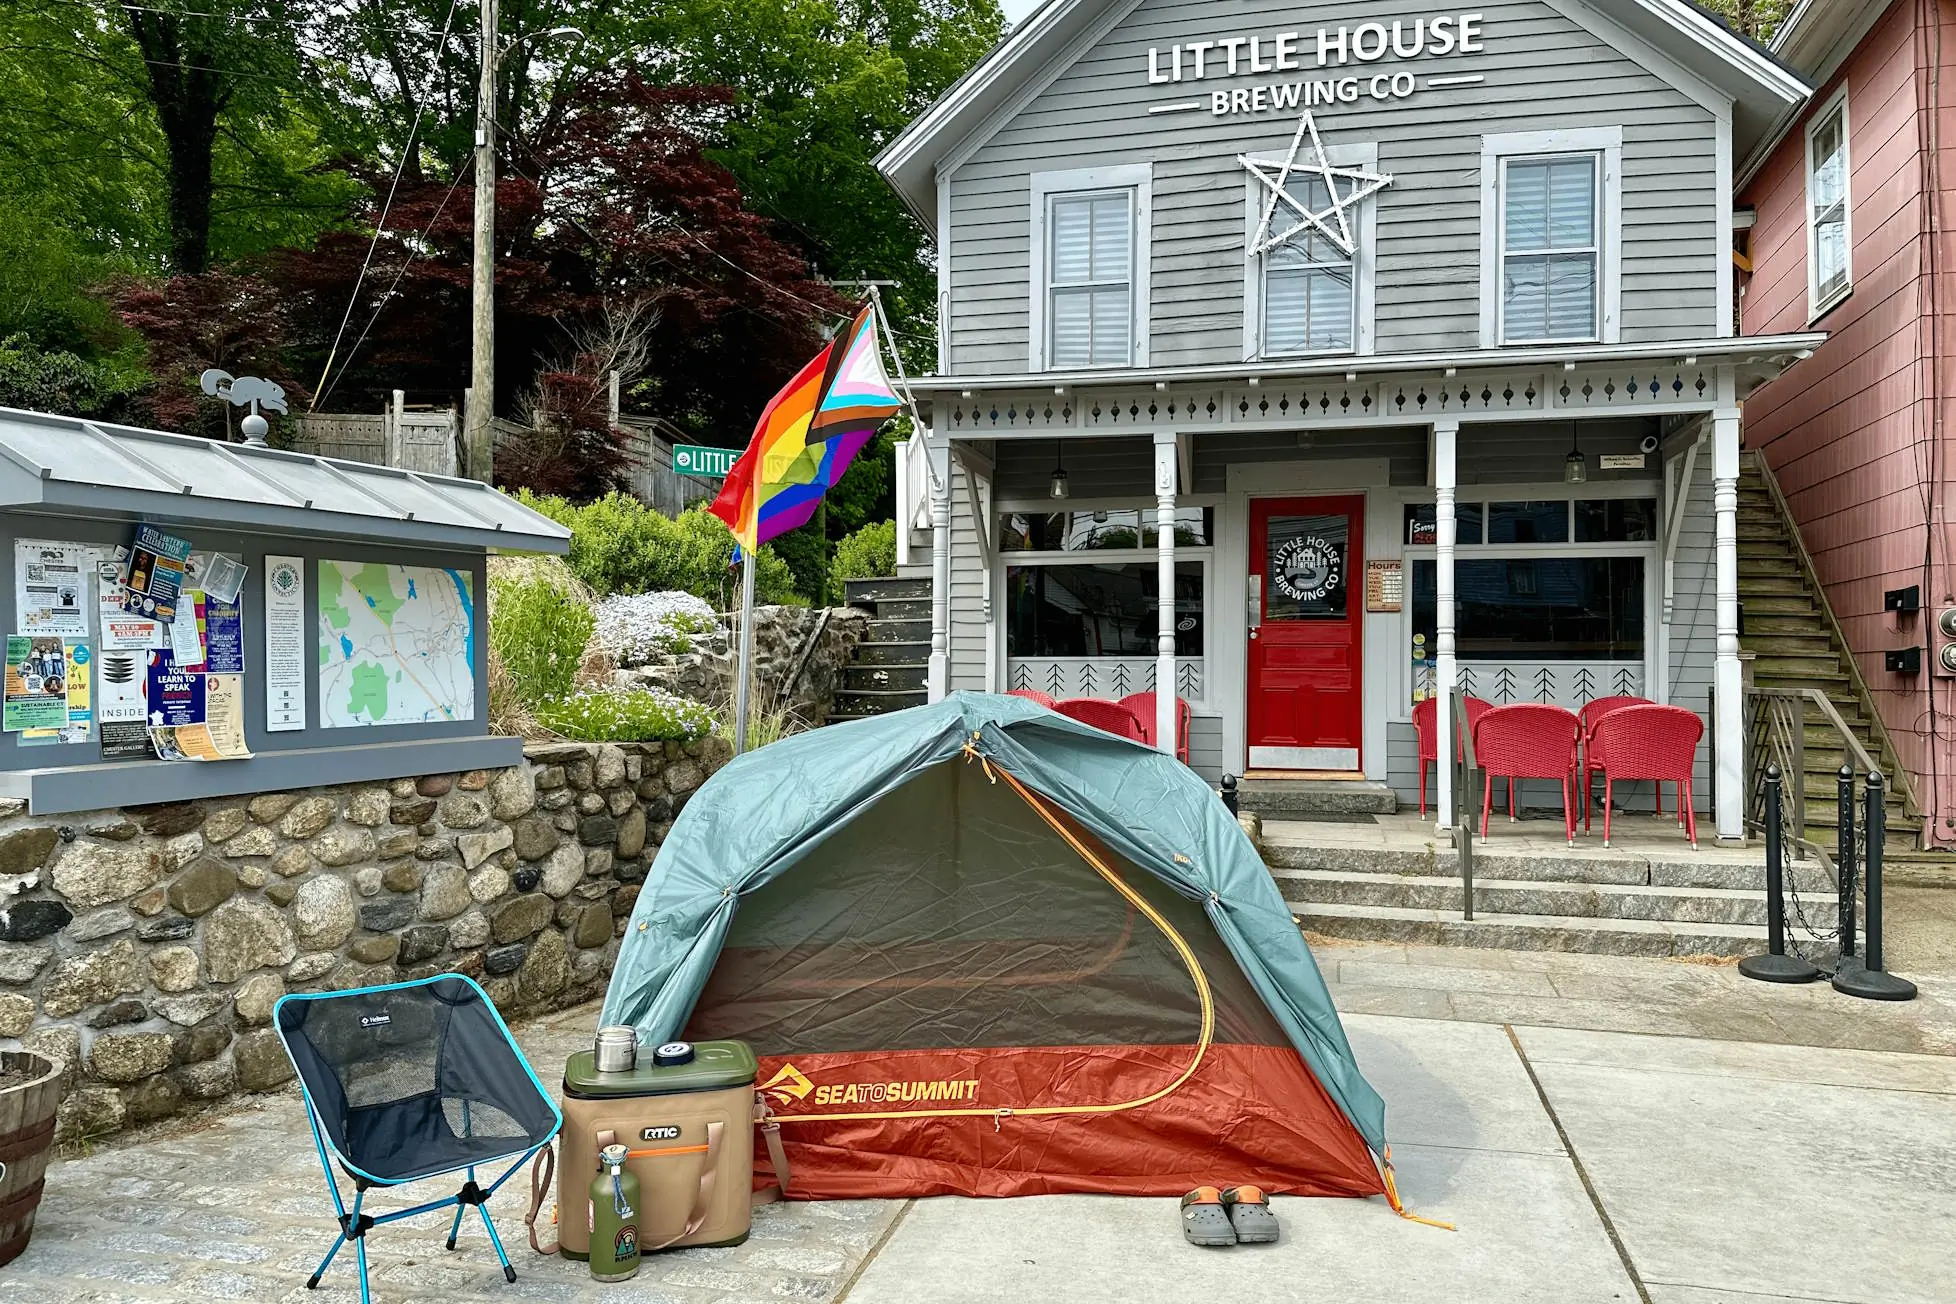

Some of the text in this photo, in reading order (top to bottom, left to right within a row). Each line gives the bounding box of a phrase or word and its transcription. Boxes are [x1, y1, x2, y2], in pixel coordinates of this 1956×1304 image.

[1148, 13, 1484, 84] LITTLE HOUSE
[1212, 71, 1416, 115] BREWING CO
[692, 451, 737, 474] LITTLE
[1413, 523, 1436, 533] Sorry
[1274, 536, 1340, 565] LITTLE HOUSE
[1368, 562, 1401, 570] Hours
[1275, 574, 1339, 601] BREWING CO
[158, 676, 183, 684] LEARN
[102, 708, 144, 717] INSIDE
[644, 1127, 678, 1139] RTIC
